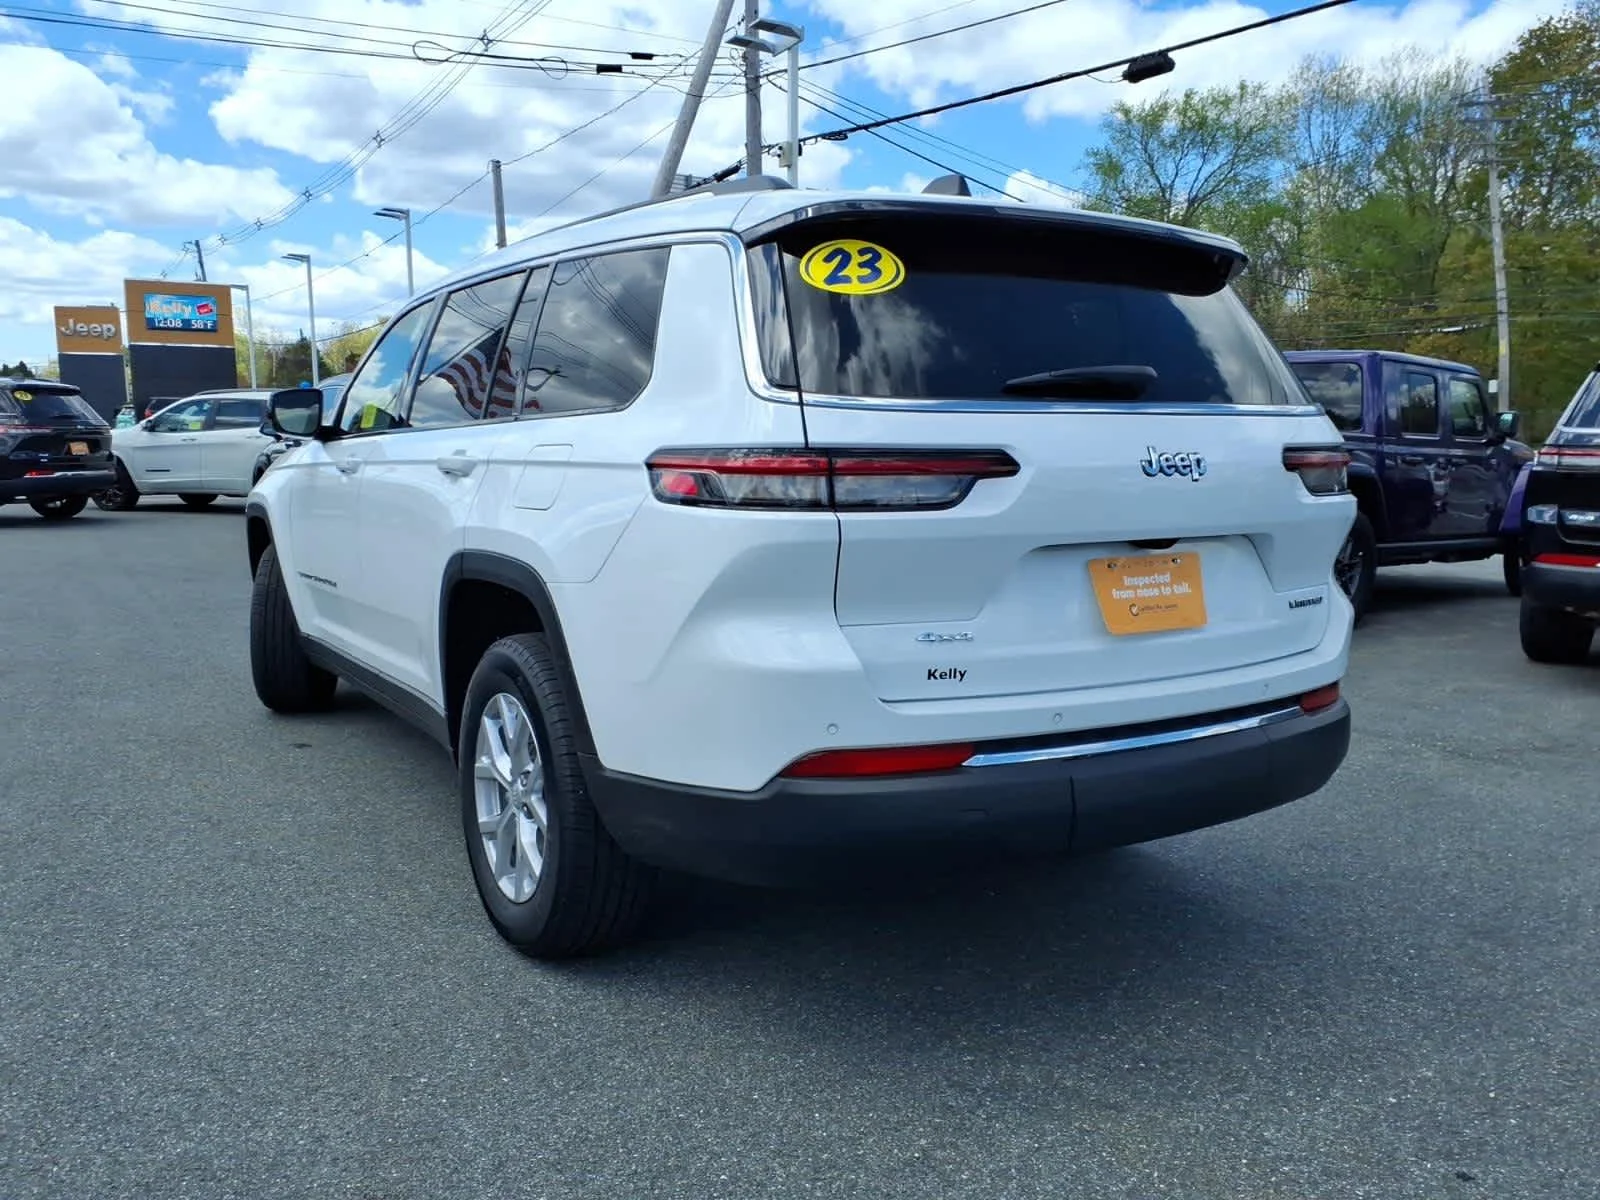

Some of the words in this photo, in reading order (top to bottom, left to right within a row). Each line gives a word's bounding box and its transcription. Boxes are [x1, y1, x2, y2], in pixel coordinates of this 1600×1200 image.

[822, 247, 882, 285] 23
[60, 319, 116, 339] Jeep
[1140, 446, 1207, 482] Jeep
[1123, 572, 1171, 586] Inspected
[1112, 588, 1135, 599] from
[1137, 588, 1160, 598] nose
[1161, 585, 1172, 596] to
[927, 667, 968, 683] Kelly
